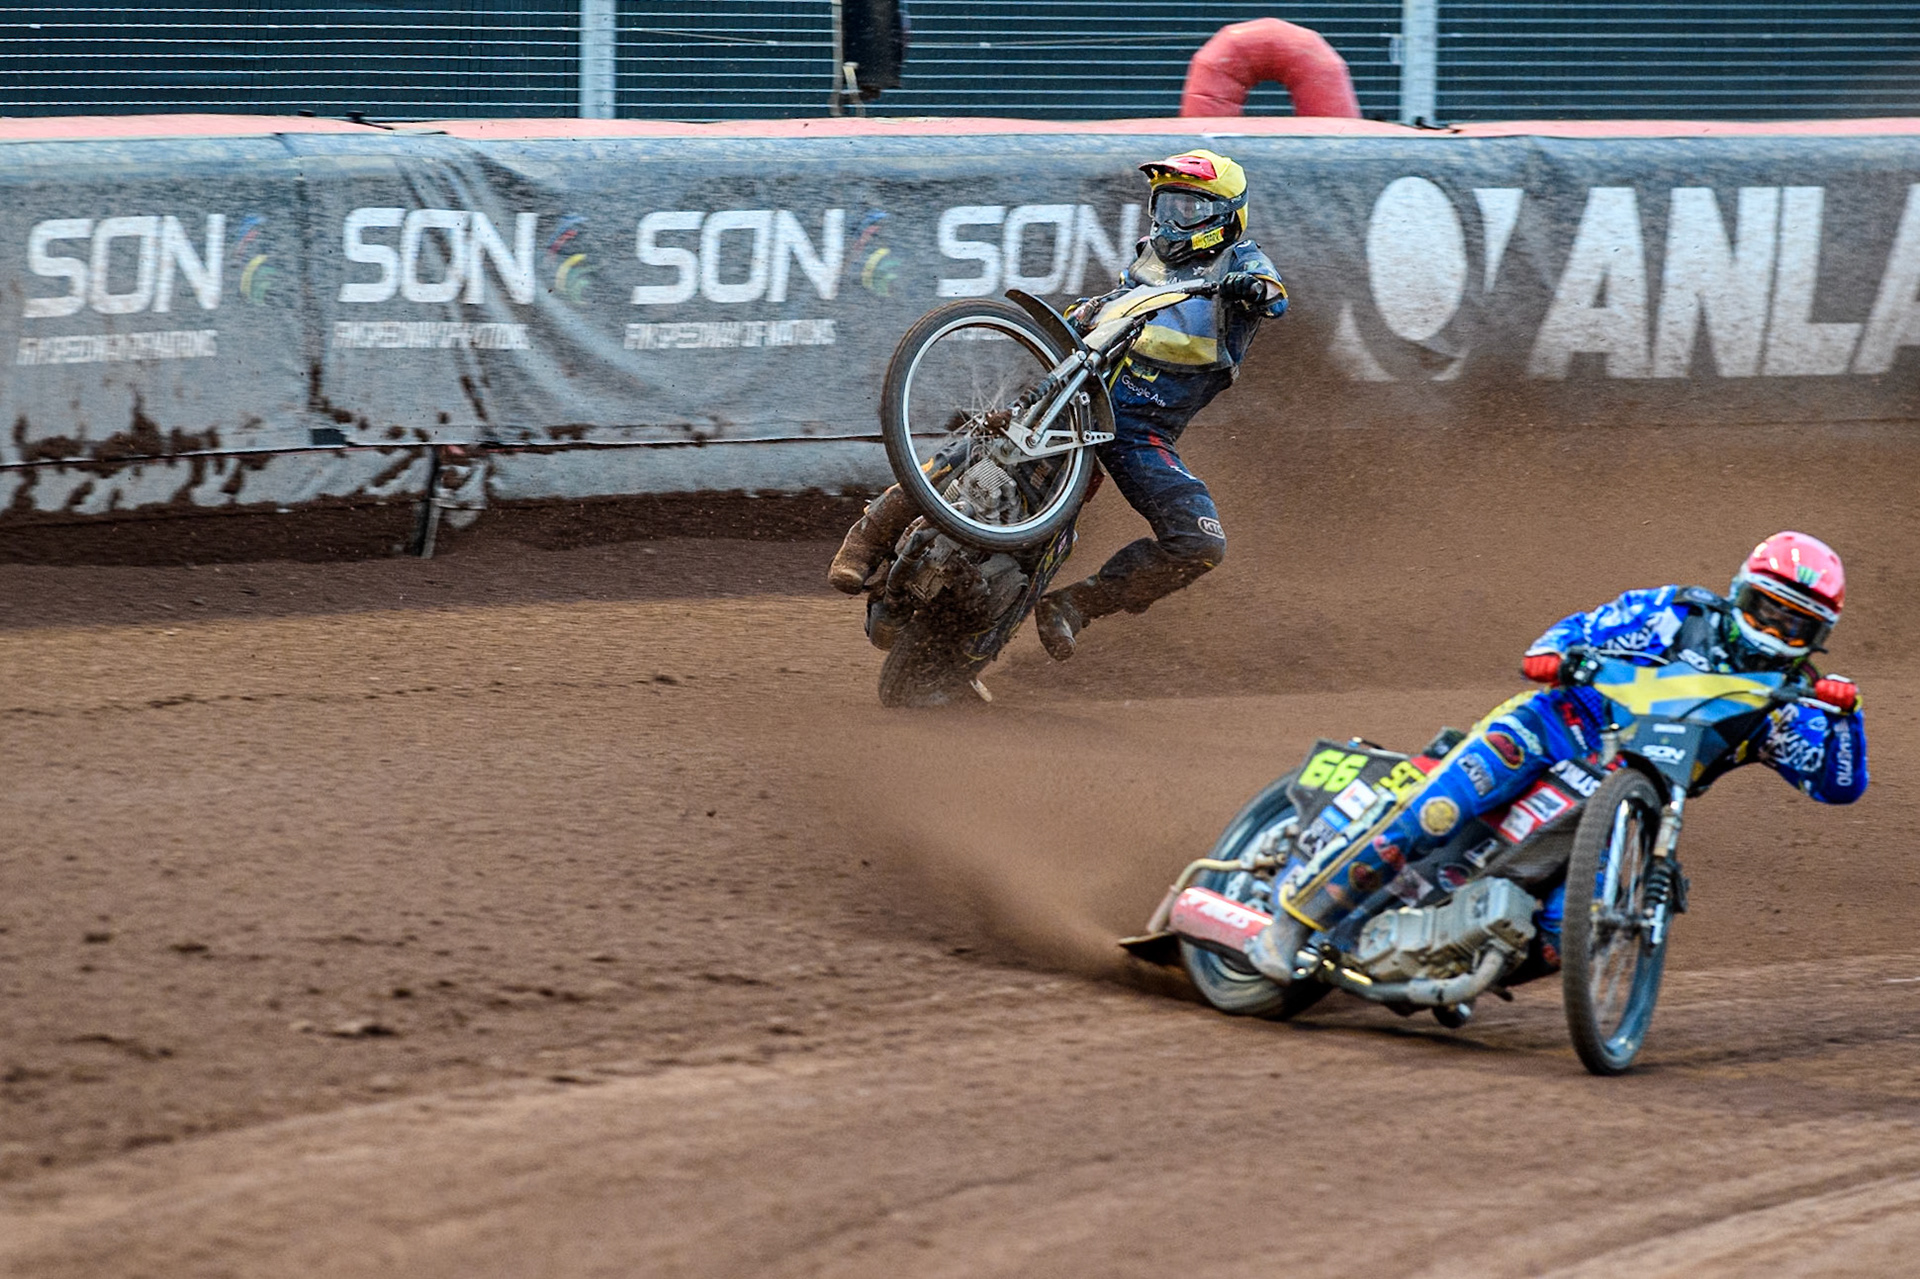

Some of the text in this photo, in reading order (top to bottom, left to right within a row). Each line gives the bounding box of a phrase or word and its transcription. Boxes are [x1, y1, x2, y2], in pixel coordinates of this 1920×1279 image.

[22, 213, 226, 318] SON
[338, 207, 539, 305] SON
[630, 208, 846, 305] SON
[936, 203, 1142, 297] SON
[1121, 374, 1167, 407] Google Ads
[1298, 748, 1369, 793] 66
